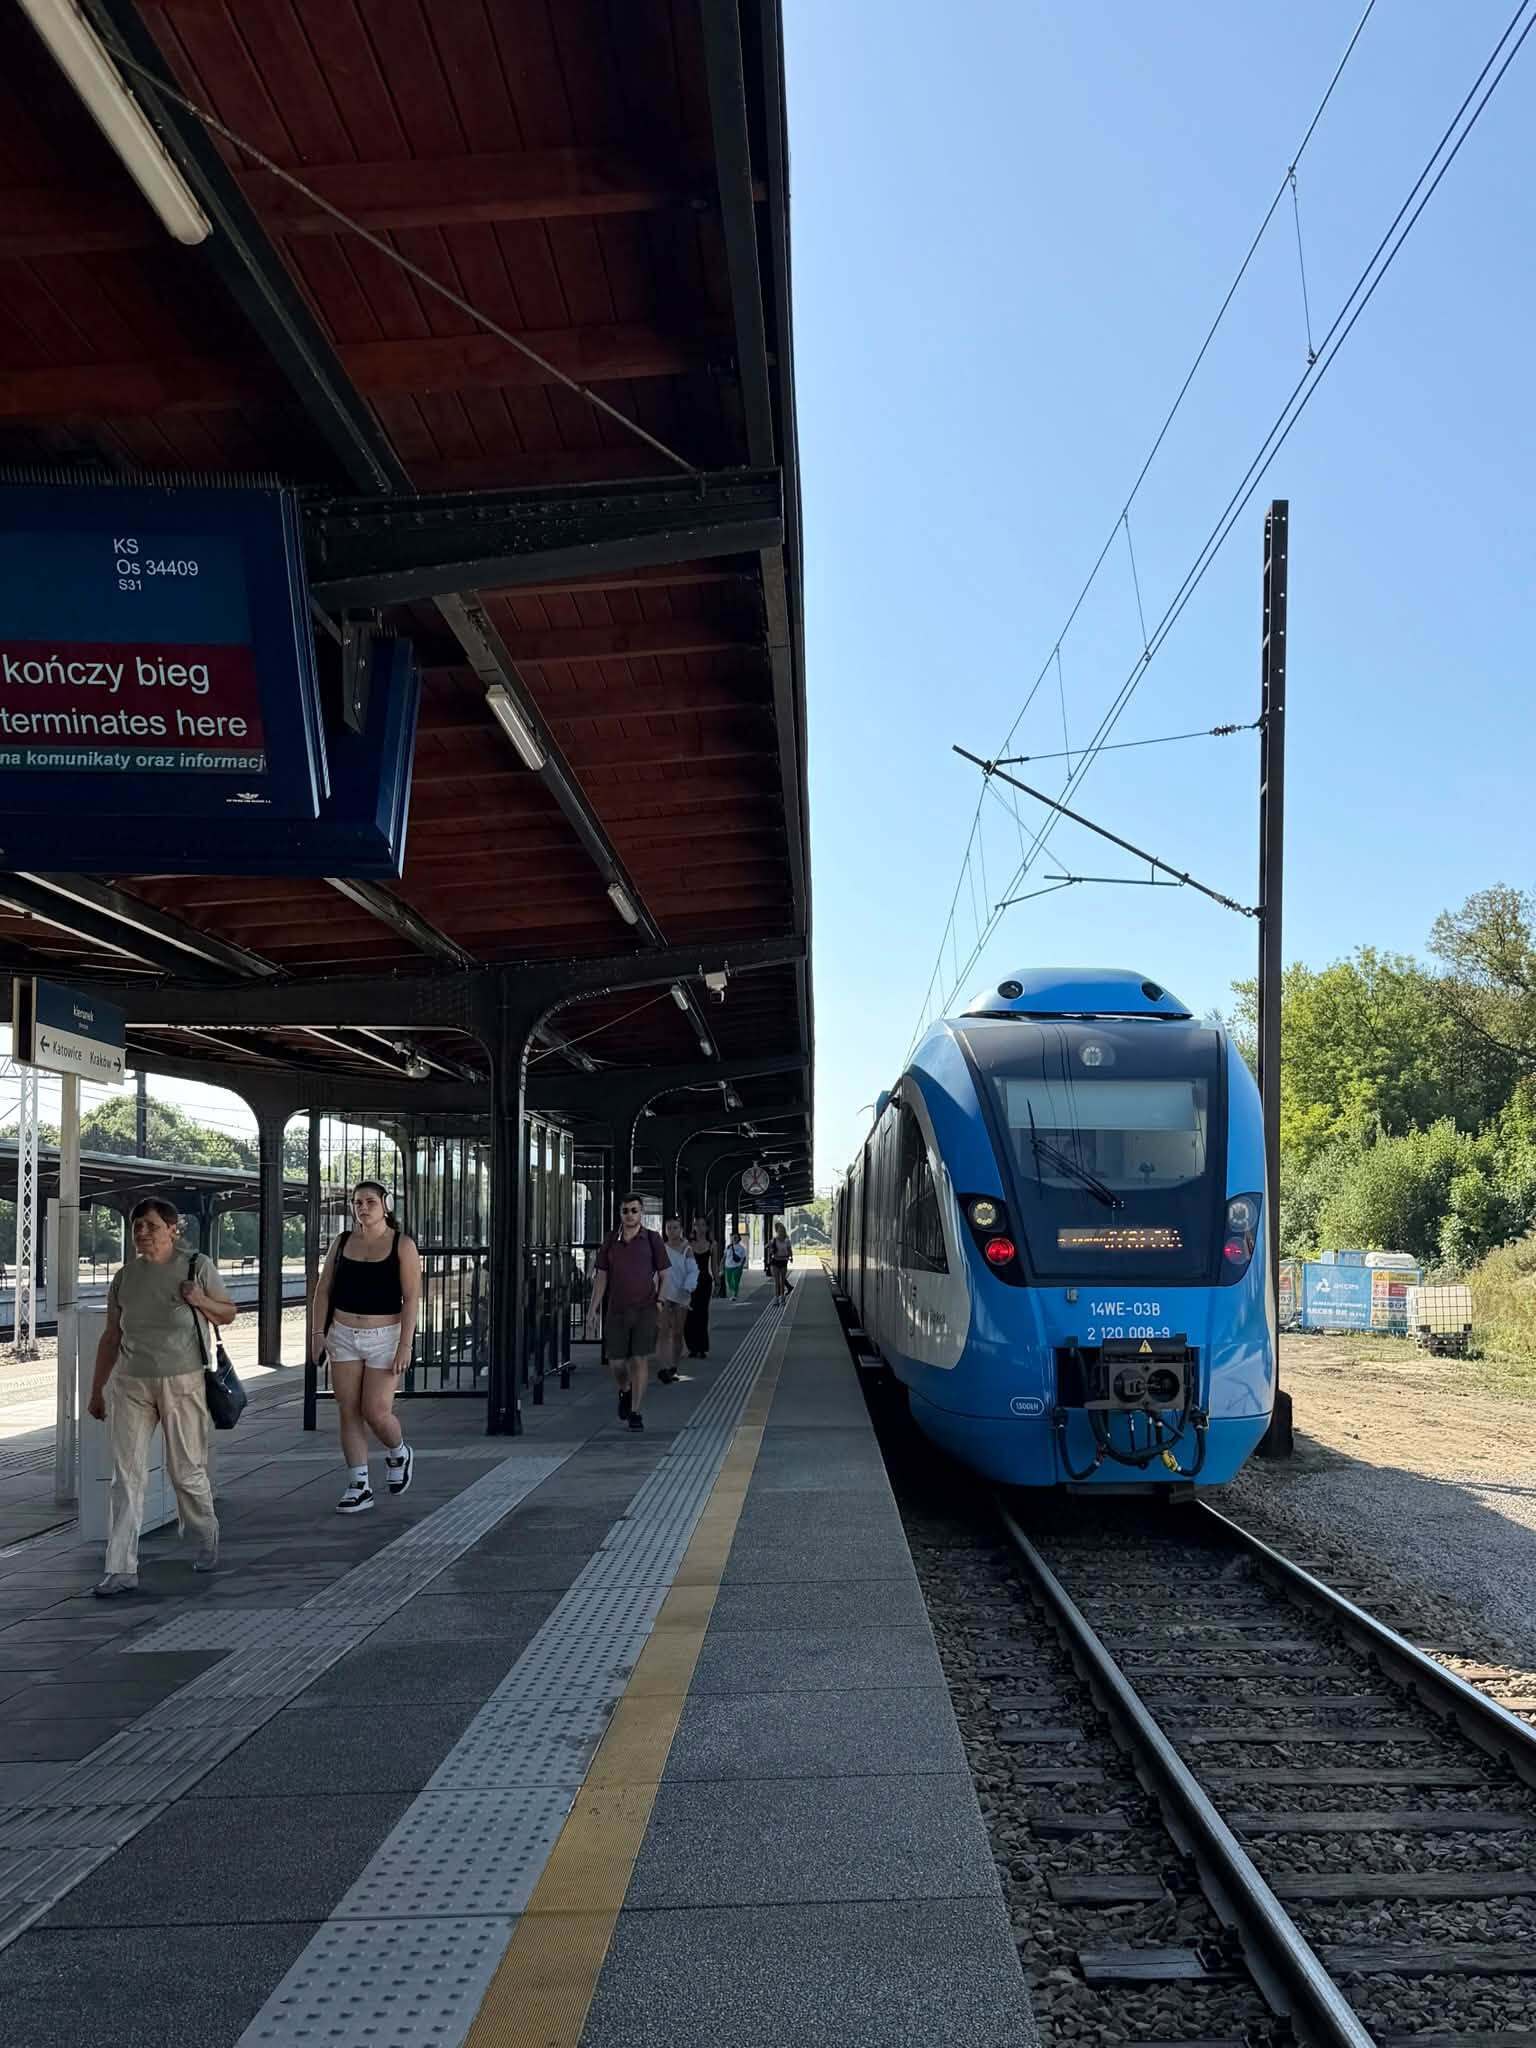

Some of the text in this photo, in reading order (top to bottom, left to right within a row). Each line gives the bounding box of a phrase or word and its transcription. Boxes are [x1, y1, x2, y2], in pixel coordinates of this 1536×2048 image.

[113, 538, 139, 554] KS
[116, 559, 199, 576] Os 34409
[118, 579, 142, 591] S31
[2, 654, 210, 694] kończy bieg
[0, 708, 248, 738] terminates here
[26, 750, 131, 770] komunikaty
[136, 754, 175, 768] oraz
[53, 1041, 112, 1069] Katowice Kraków
[1090, 1302, 1161, 1316] 14WE-03B
[1087, 1326, 1170, 1341] 2 120 008-9
